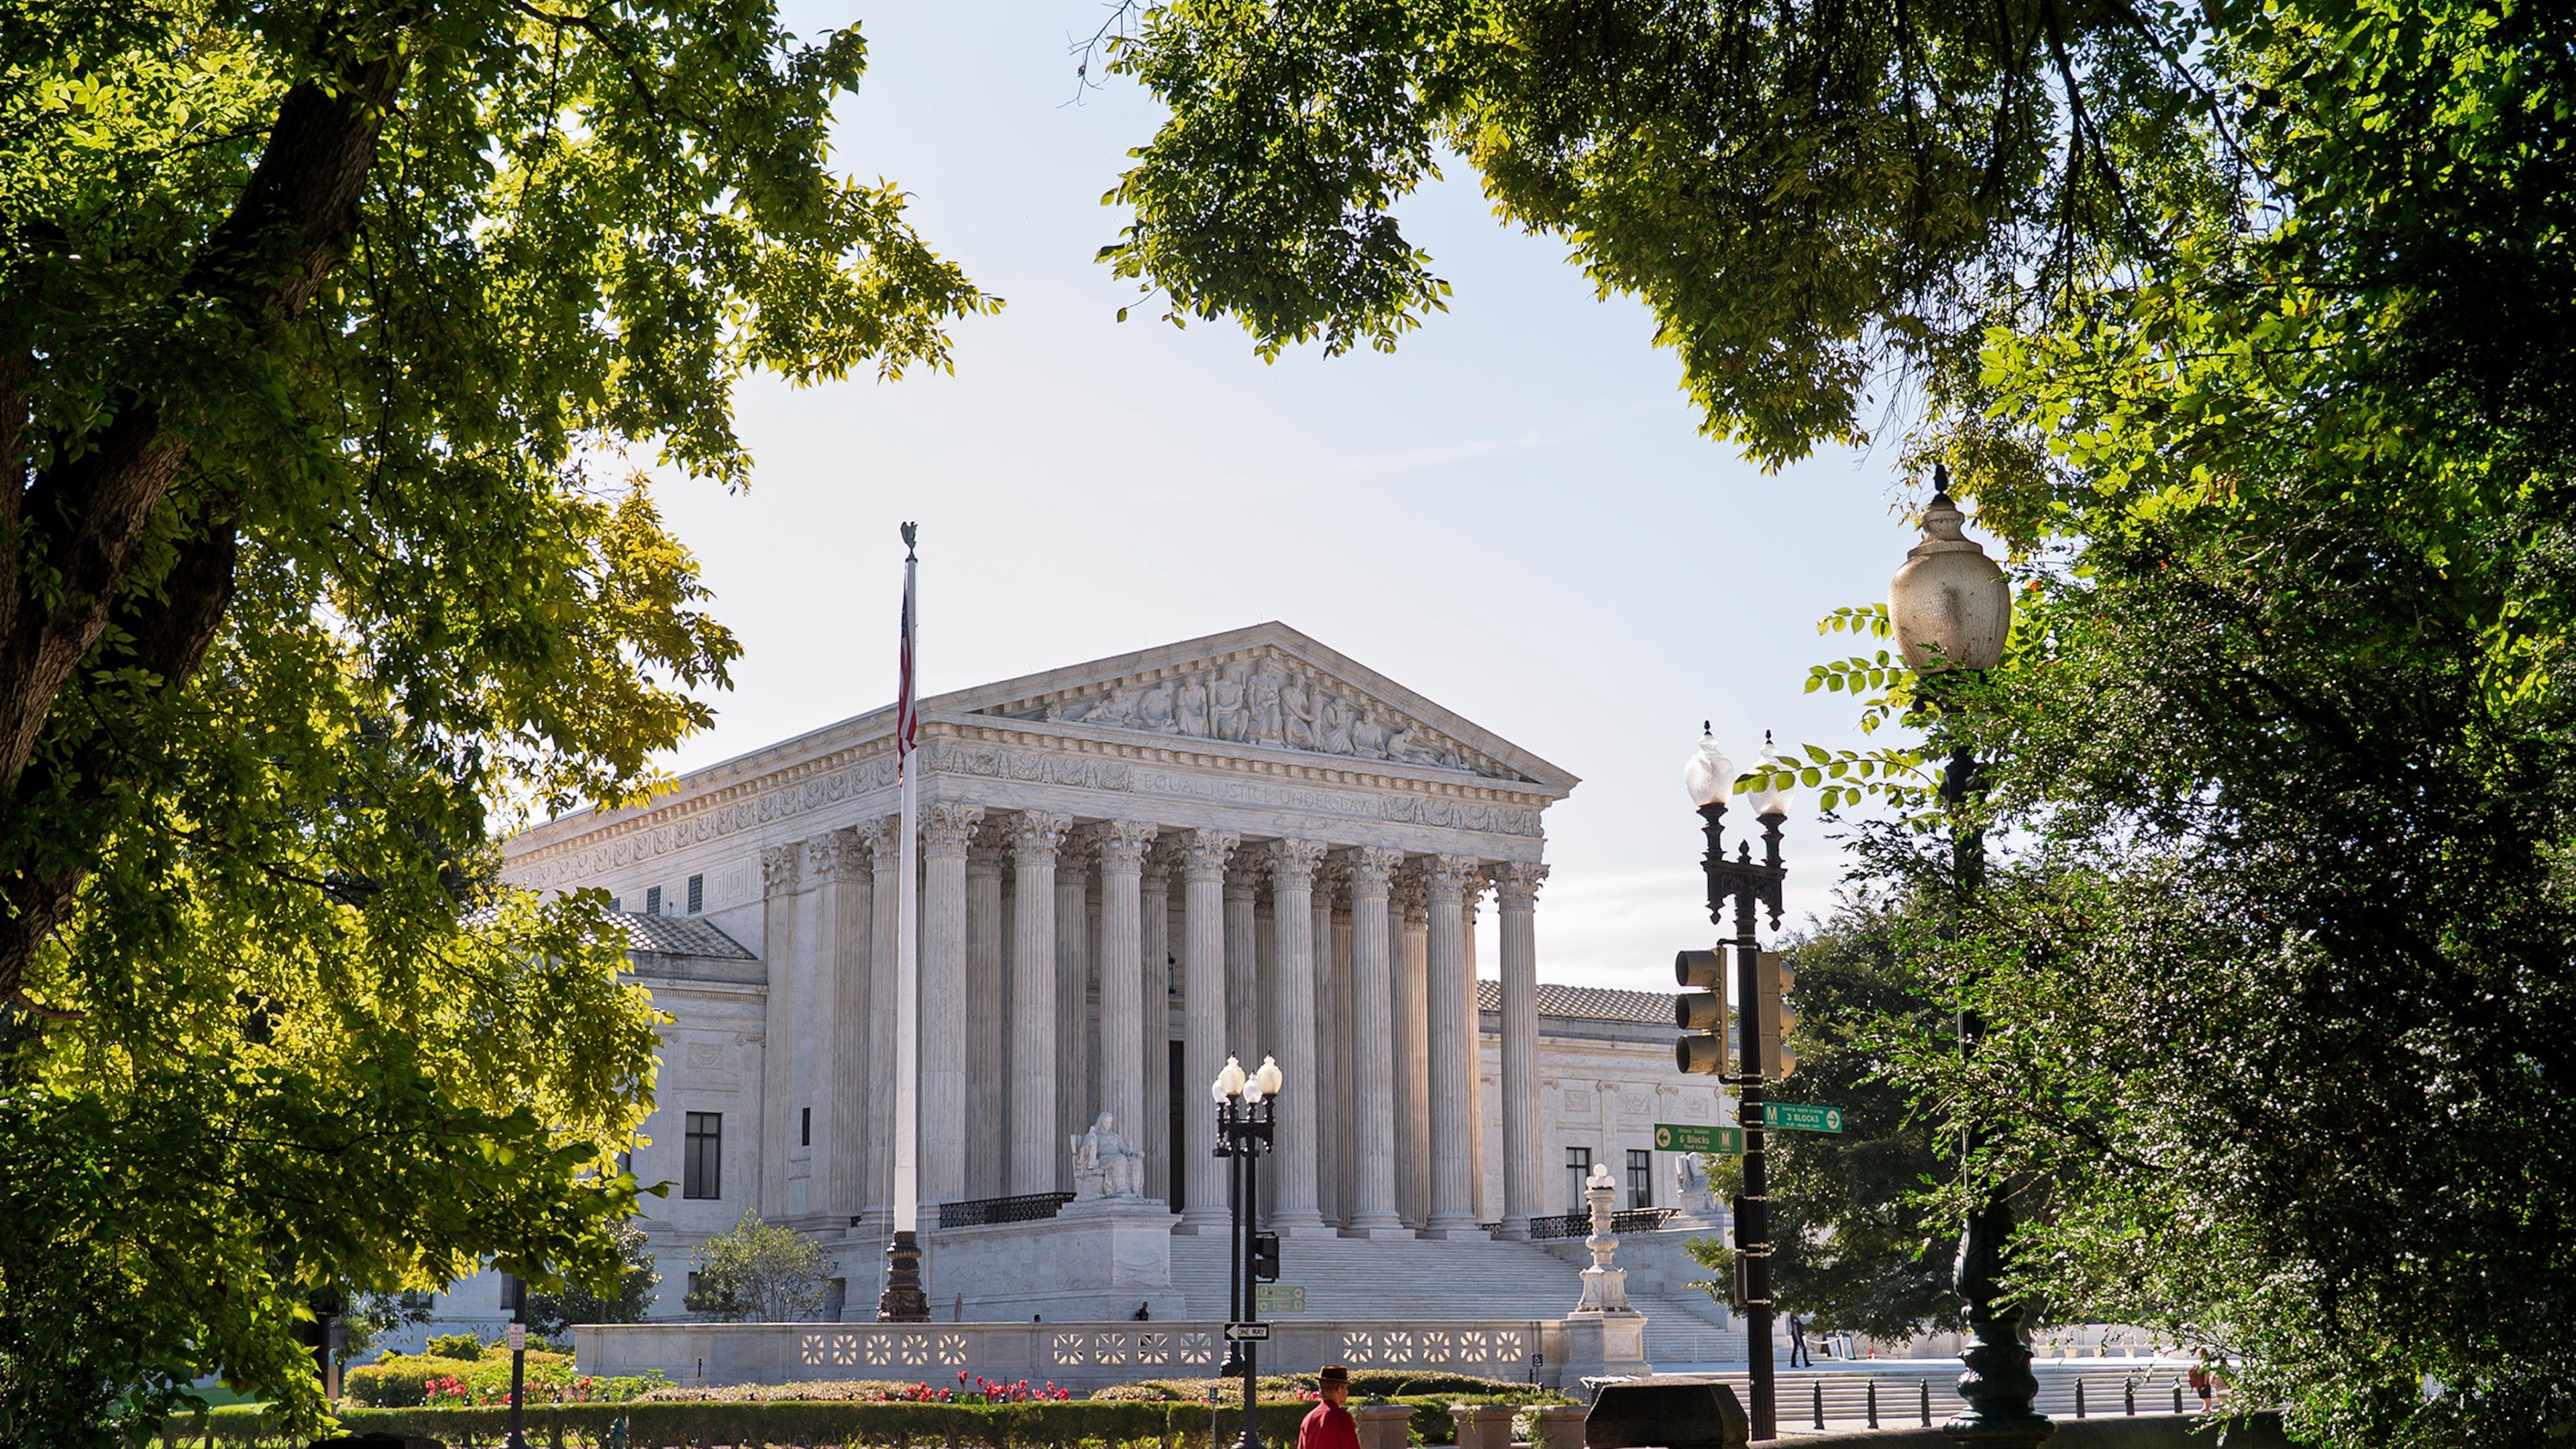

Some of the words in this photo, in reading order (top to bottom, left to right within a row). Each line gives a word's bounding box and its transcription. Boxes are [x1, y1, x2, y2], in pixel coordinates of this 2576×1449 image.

[1144, 773, 1203, 795] EQUAL
[1208, 779, 1271, 802] JUSTICE
[1279, 789, 1335, 810] UNDER
[1340, 796, 1373, 814] LAW
[1766, 1106, 1778, 1120] M
[1793, 1114, 1819, 1123] BLOCKS
[1679, 1134, 1684, 1144] 6
[1687, 1134, 1709, 1144] Blocks
